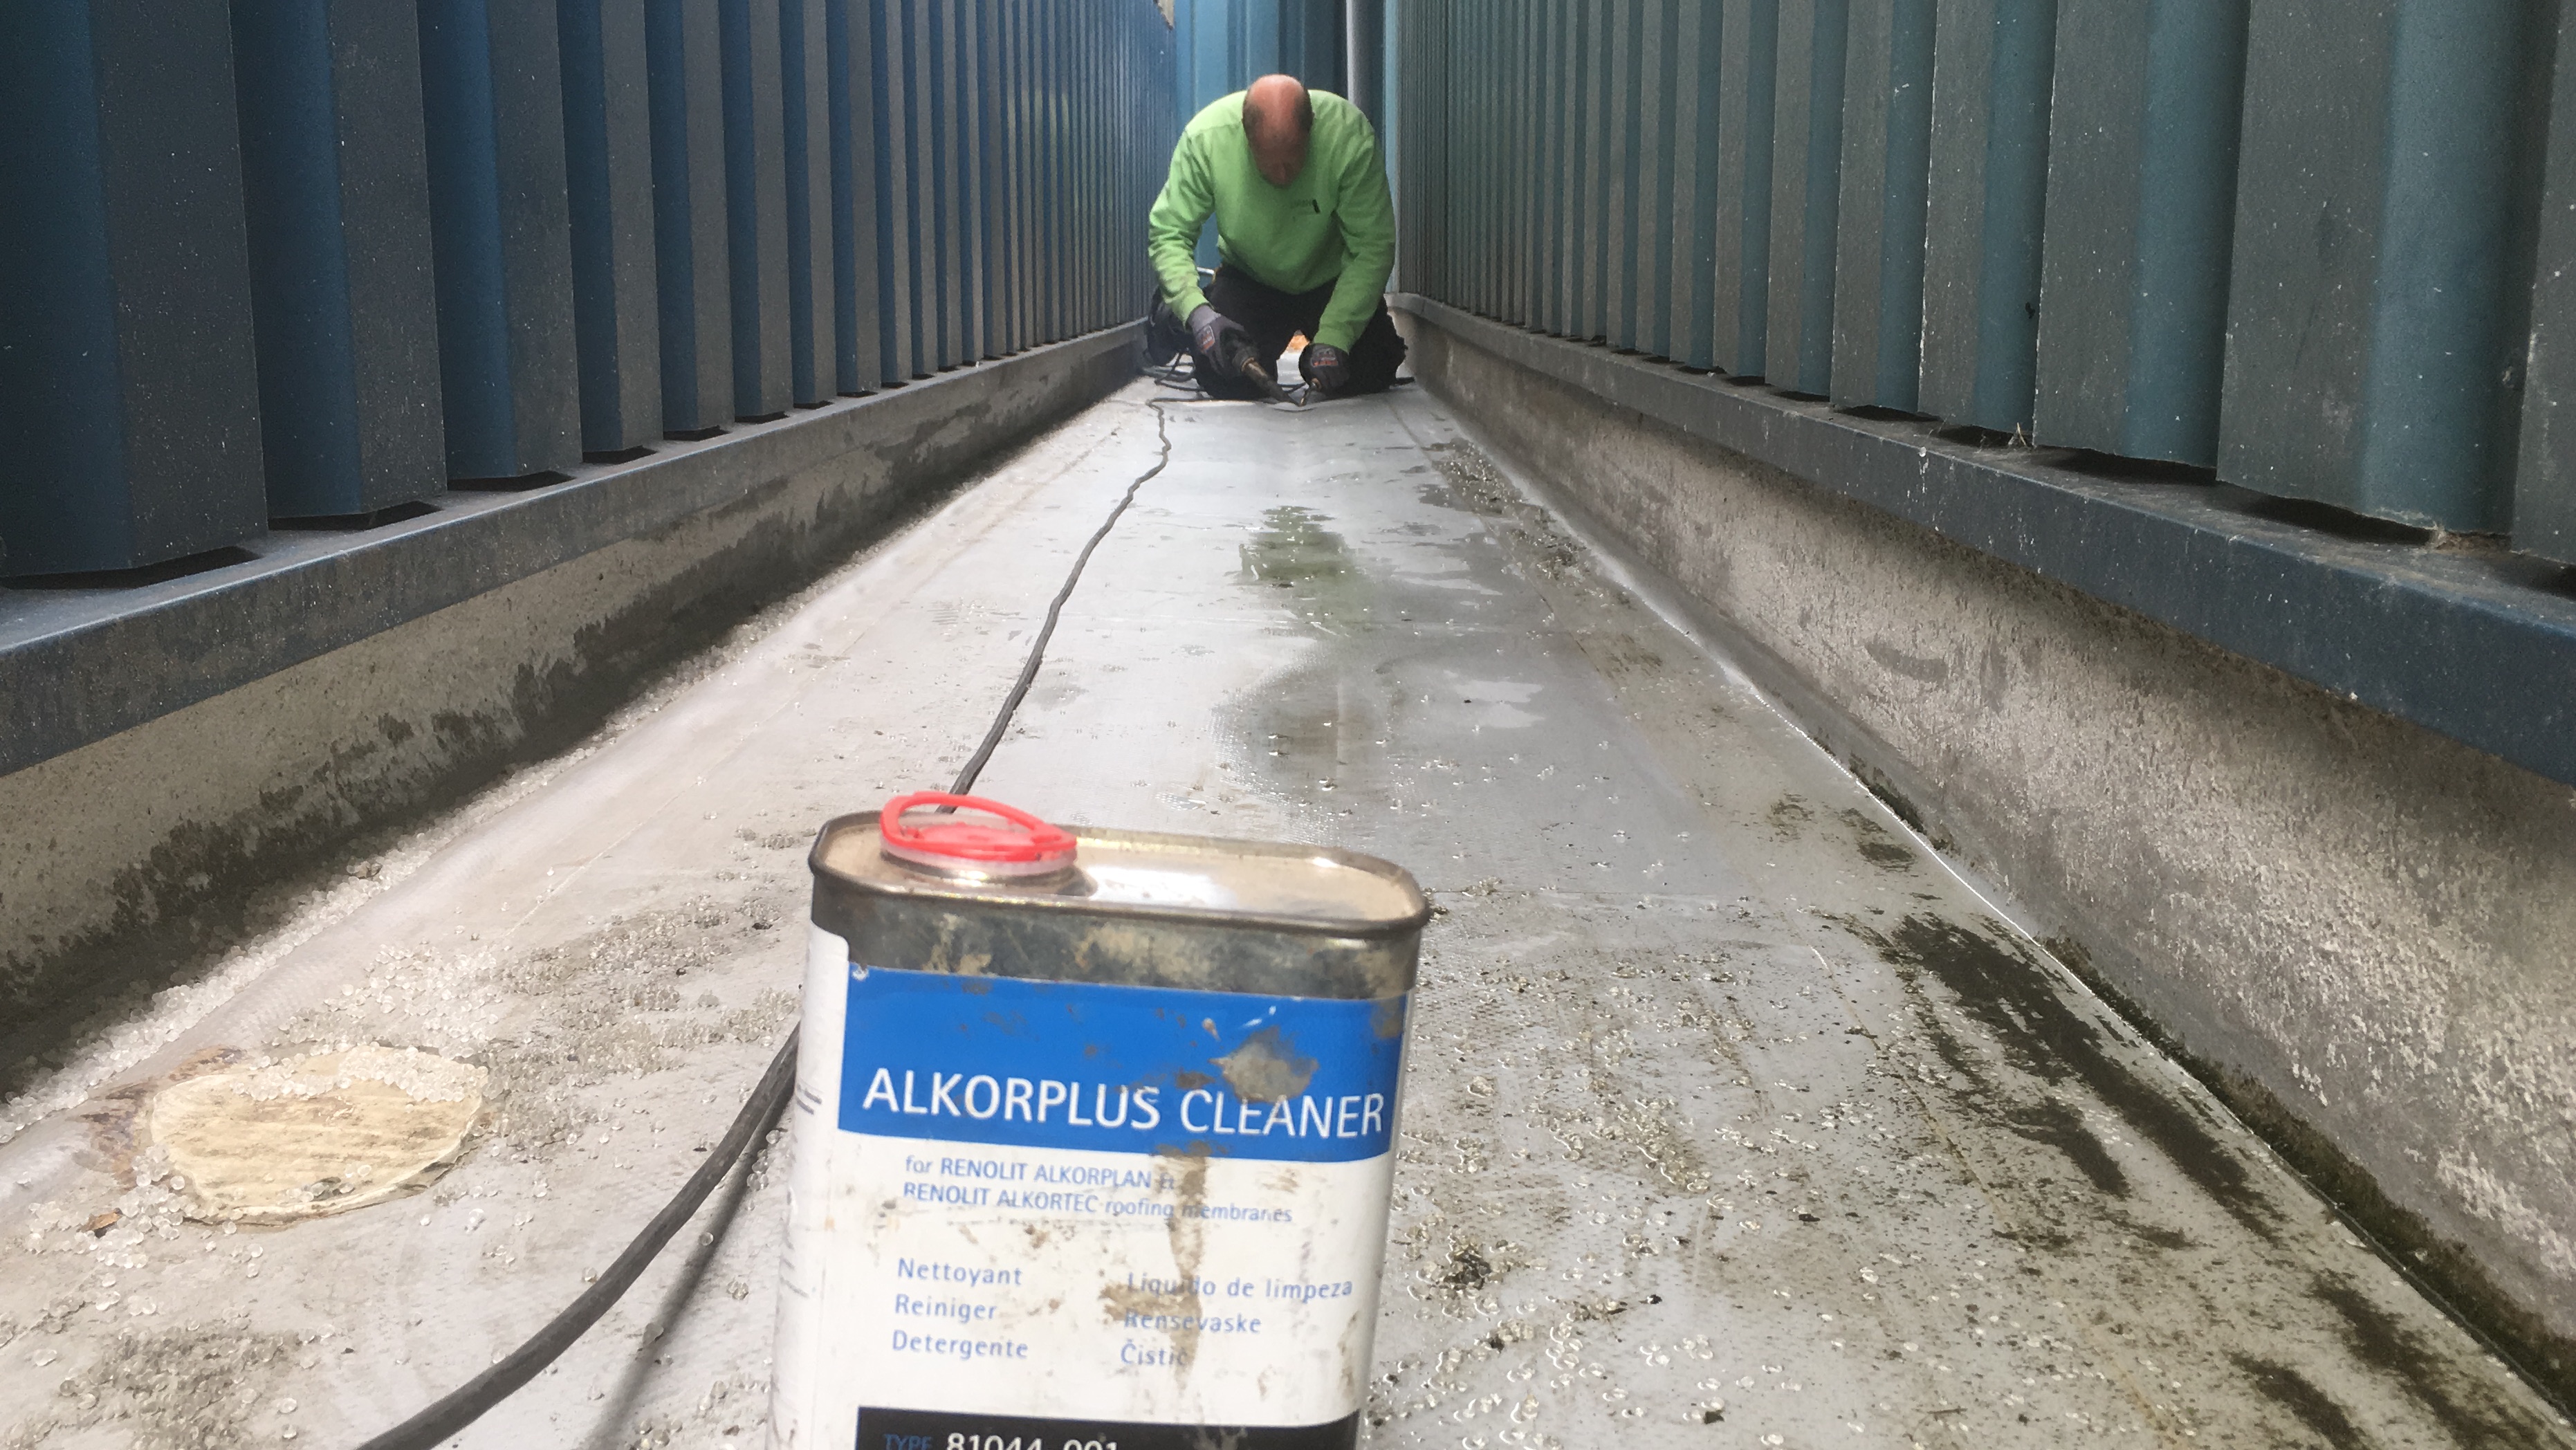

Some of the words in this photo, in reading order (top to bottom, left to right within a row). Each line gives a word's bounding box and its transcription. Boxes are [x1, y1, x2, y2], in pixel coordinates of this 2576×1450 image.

[863, 1067, 1160, 1130] ALKORPLUS
[1180, 1089, 1384, 1138] CLEANER
[905, 1155, 932, 1174] for
[941, 1157, 1028, 1181] RENOLIT
[1034, 1164, 1151, 1189] ALKORPLAN
[903, 1182, 991, 1205] RENOLIT
[996, 1189, 1098, 1213] ALKORTEC
[1106, 1198, 1174, 1219] roofing
[898, 1257, 1023, 1287] Nettoyant
[1227, 1277, 1254, 1298] de
[1266, 1278, 1353, 1303] limpeza
[895, 1294, 997, 1324] Reiniger
[1123, 1307, 1261, 1334] Rensevaske
[892, 1329, 1029, 1361] Detergente
[883, 1433, 933, 1450] TYPE
